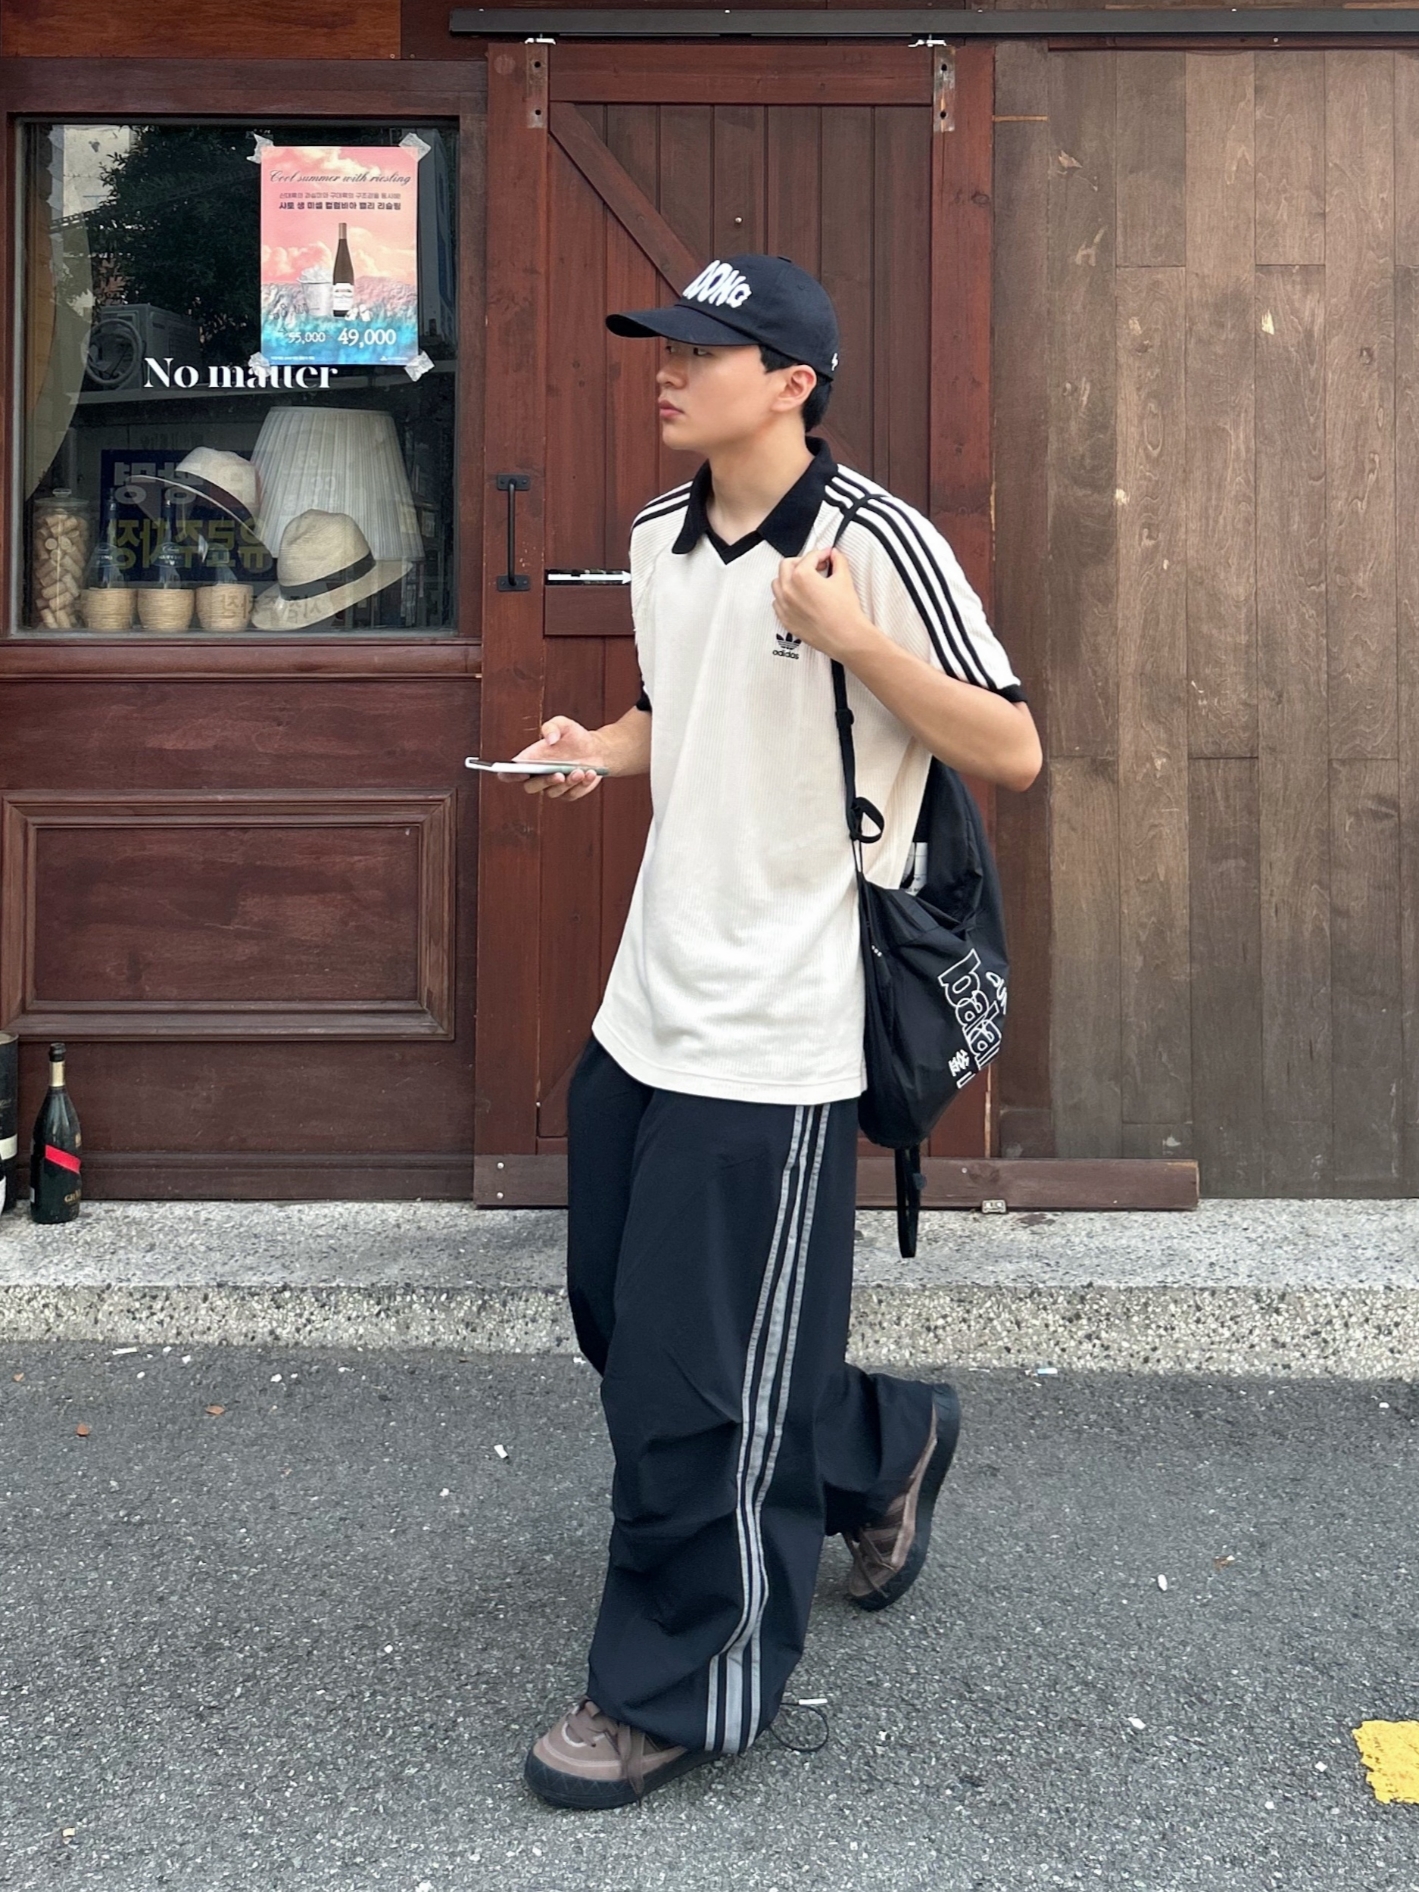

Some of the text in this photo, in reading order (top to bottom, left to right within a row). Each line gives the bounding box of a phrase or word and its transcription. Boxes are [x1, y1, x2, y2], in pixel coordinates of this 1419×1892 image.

[269, 169, 300, 182] Cool
[342, 171, 370, 182] with
[369, 171, 411, 186] riesling
[337, 327, 397, 348] 49,000
[143, 357, 200, 389] No
[772, 649, 799, 660] adidas
